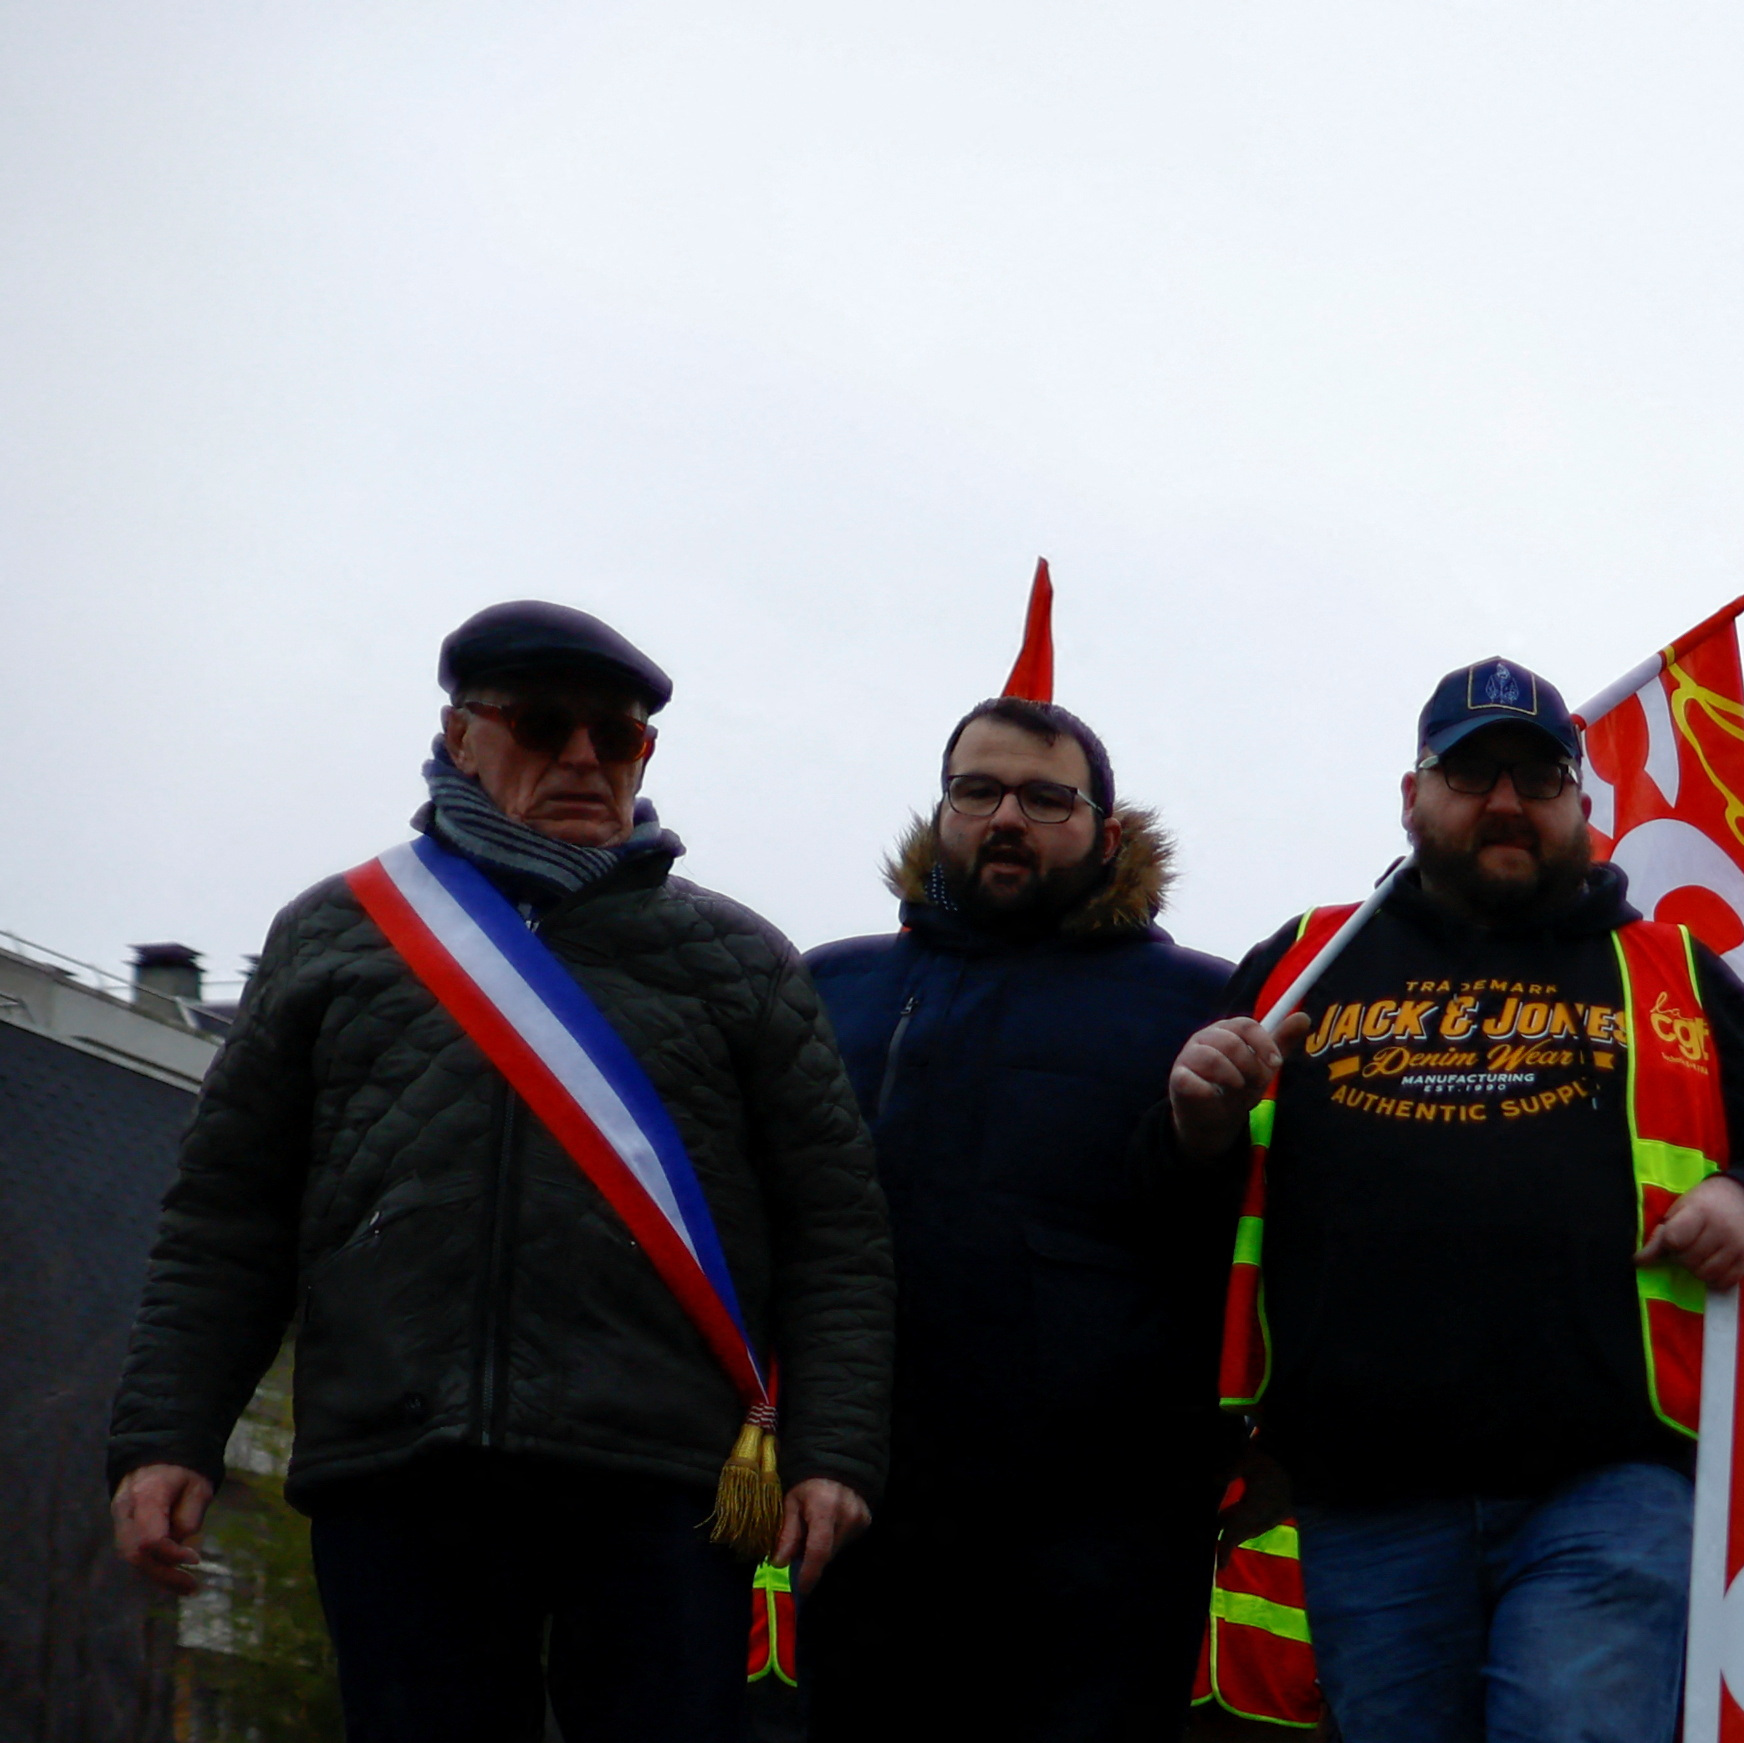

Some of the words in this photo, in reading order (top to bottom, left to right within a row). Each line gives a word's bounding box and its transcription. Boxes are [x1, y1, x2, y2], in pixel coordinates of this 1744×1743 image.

[1406, 979, 1557, 995] TRADEMARK
[1305, 1000, 1439, 1057] JACK
[1440, 995, 1479, 1040] &
[1482, 997, 1628, 1049] JONES
[1650, 1012, 1710, 1061] cgt
[1362, 1045, 1478, 1078] Denim
[1486, 1038, 1574, 1071] Wear
[1401, 1073, 1535, 1085] MANUFACTURING
[1331, 1084, 1487, 1122] AUTHENTIC
[1501, 1077, 1599, 1118] SUPPL
